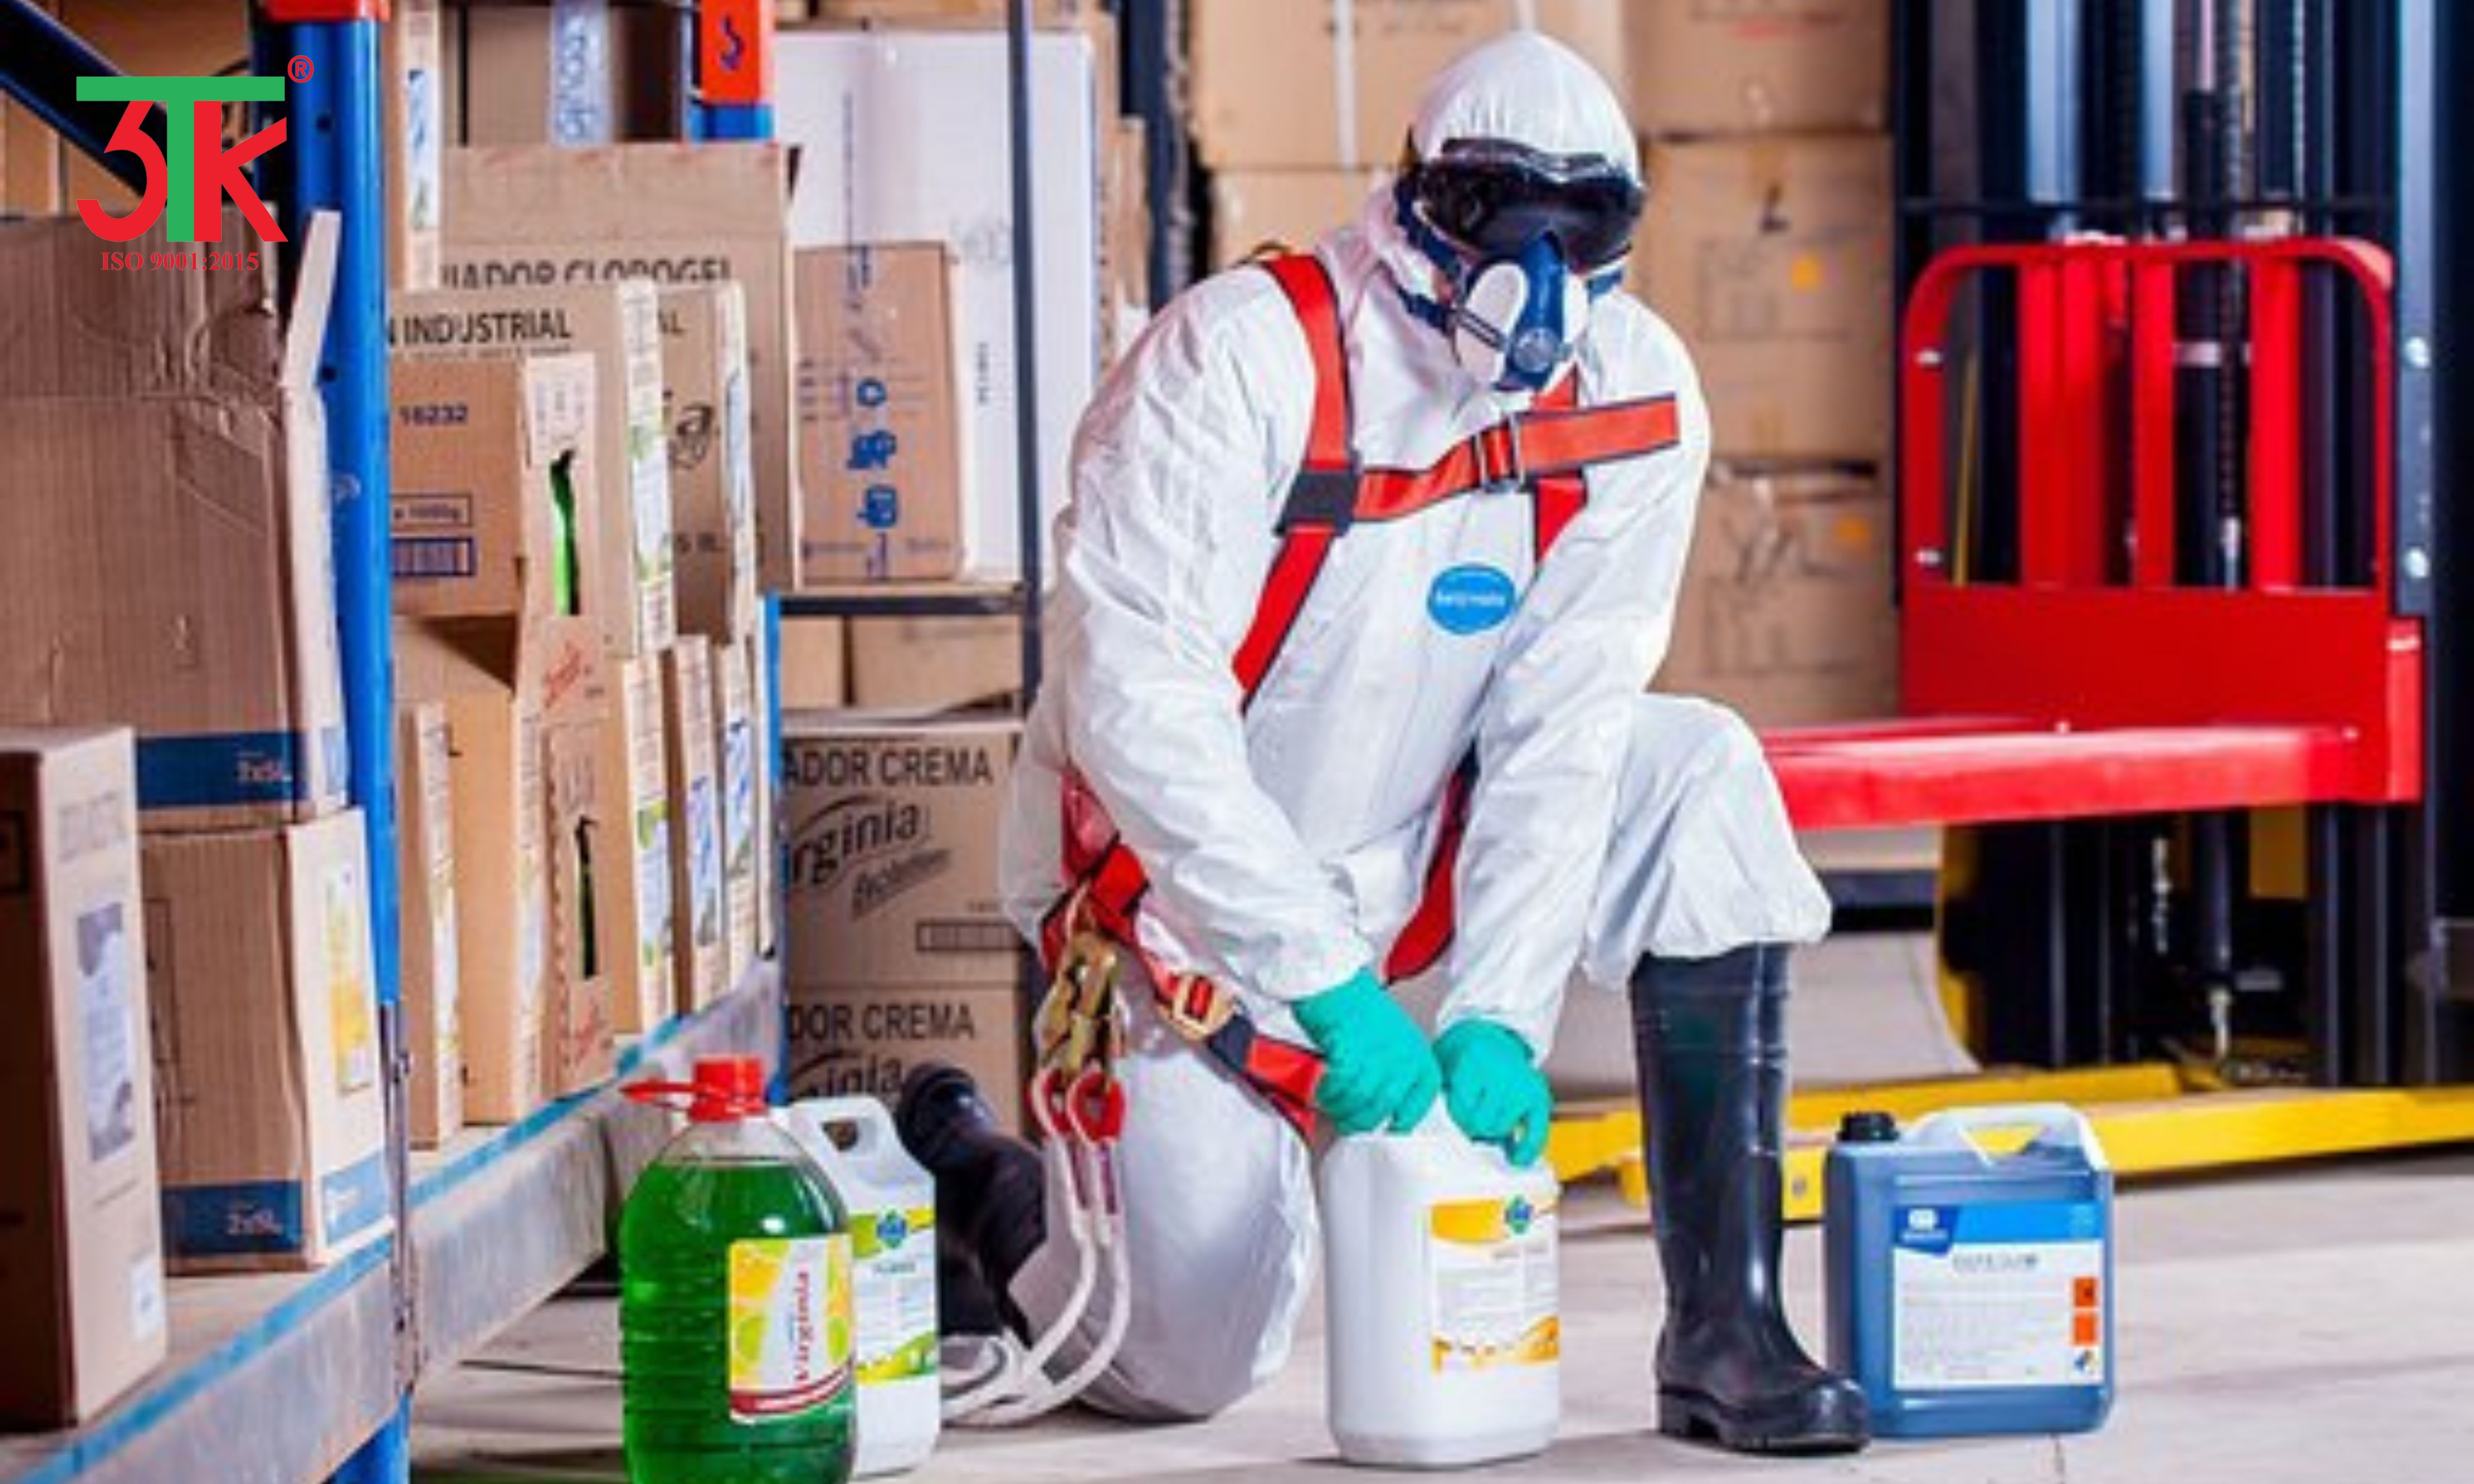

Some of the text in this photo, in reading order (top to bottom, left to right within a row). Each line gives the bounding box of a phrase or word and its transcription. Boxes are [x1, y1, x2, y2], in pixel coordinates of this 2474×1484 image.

[404, 310, 571, 344] INDUSTRIAL
[879, 747, 994, 786] CREMA
[862, 1003, 976, 1040] CREMA
